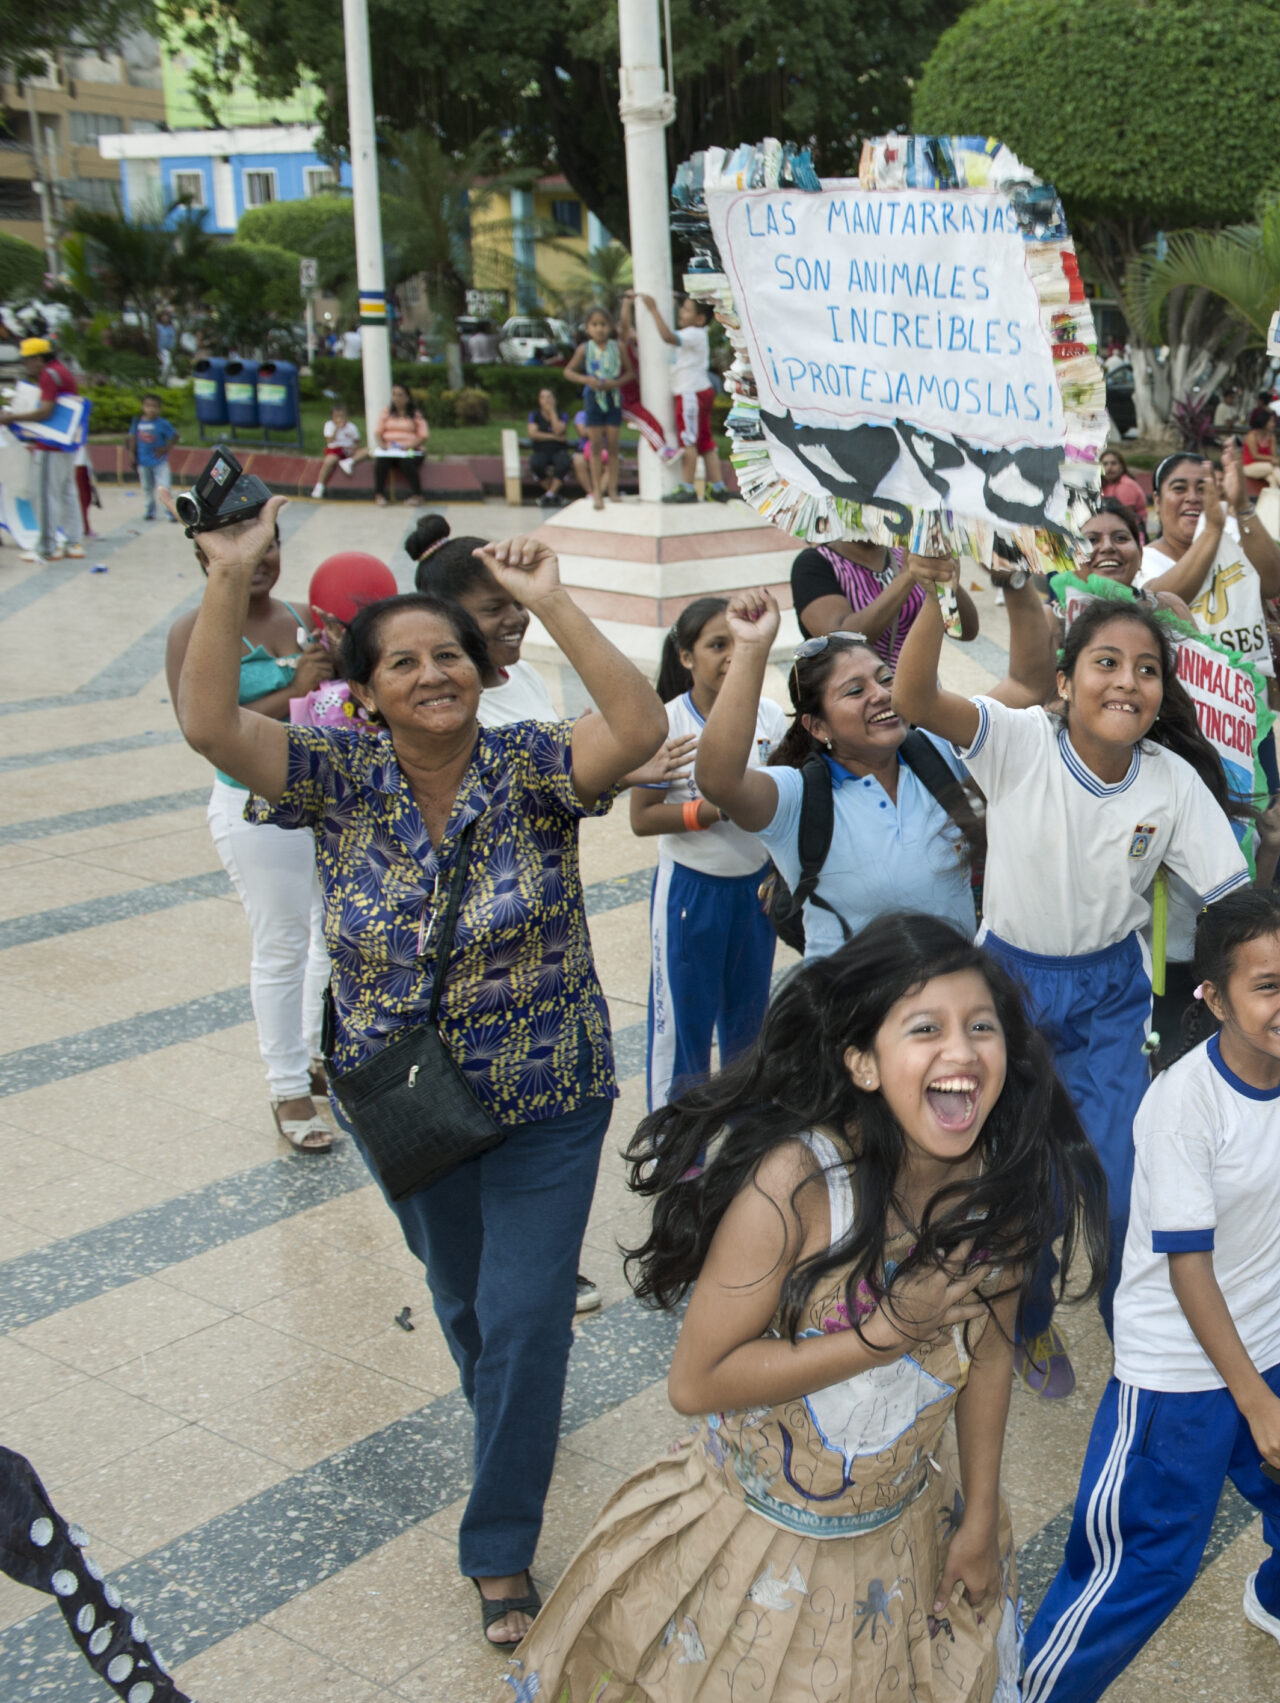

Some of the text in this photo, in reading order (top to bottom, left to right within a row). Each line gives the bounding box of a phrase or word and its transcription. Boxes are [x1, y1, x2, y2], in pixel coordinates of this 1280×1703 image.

[746, 200, 1020, 237] LAS MANTARRAYAS
[774, 254, 990, 301] SON ANIMALES
[767, 346, 1055, 428] ¡PROTEJAMOSLAS!
[1211, 624, 1265, 653] SES
[1177, 644, 1257, 715] ANIMALES
